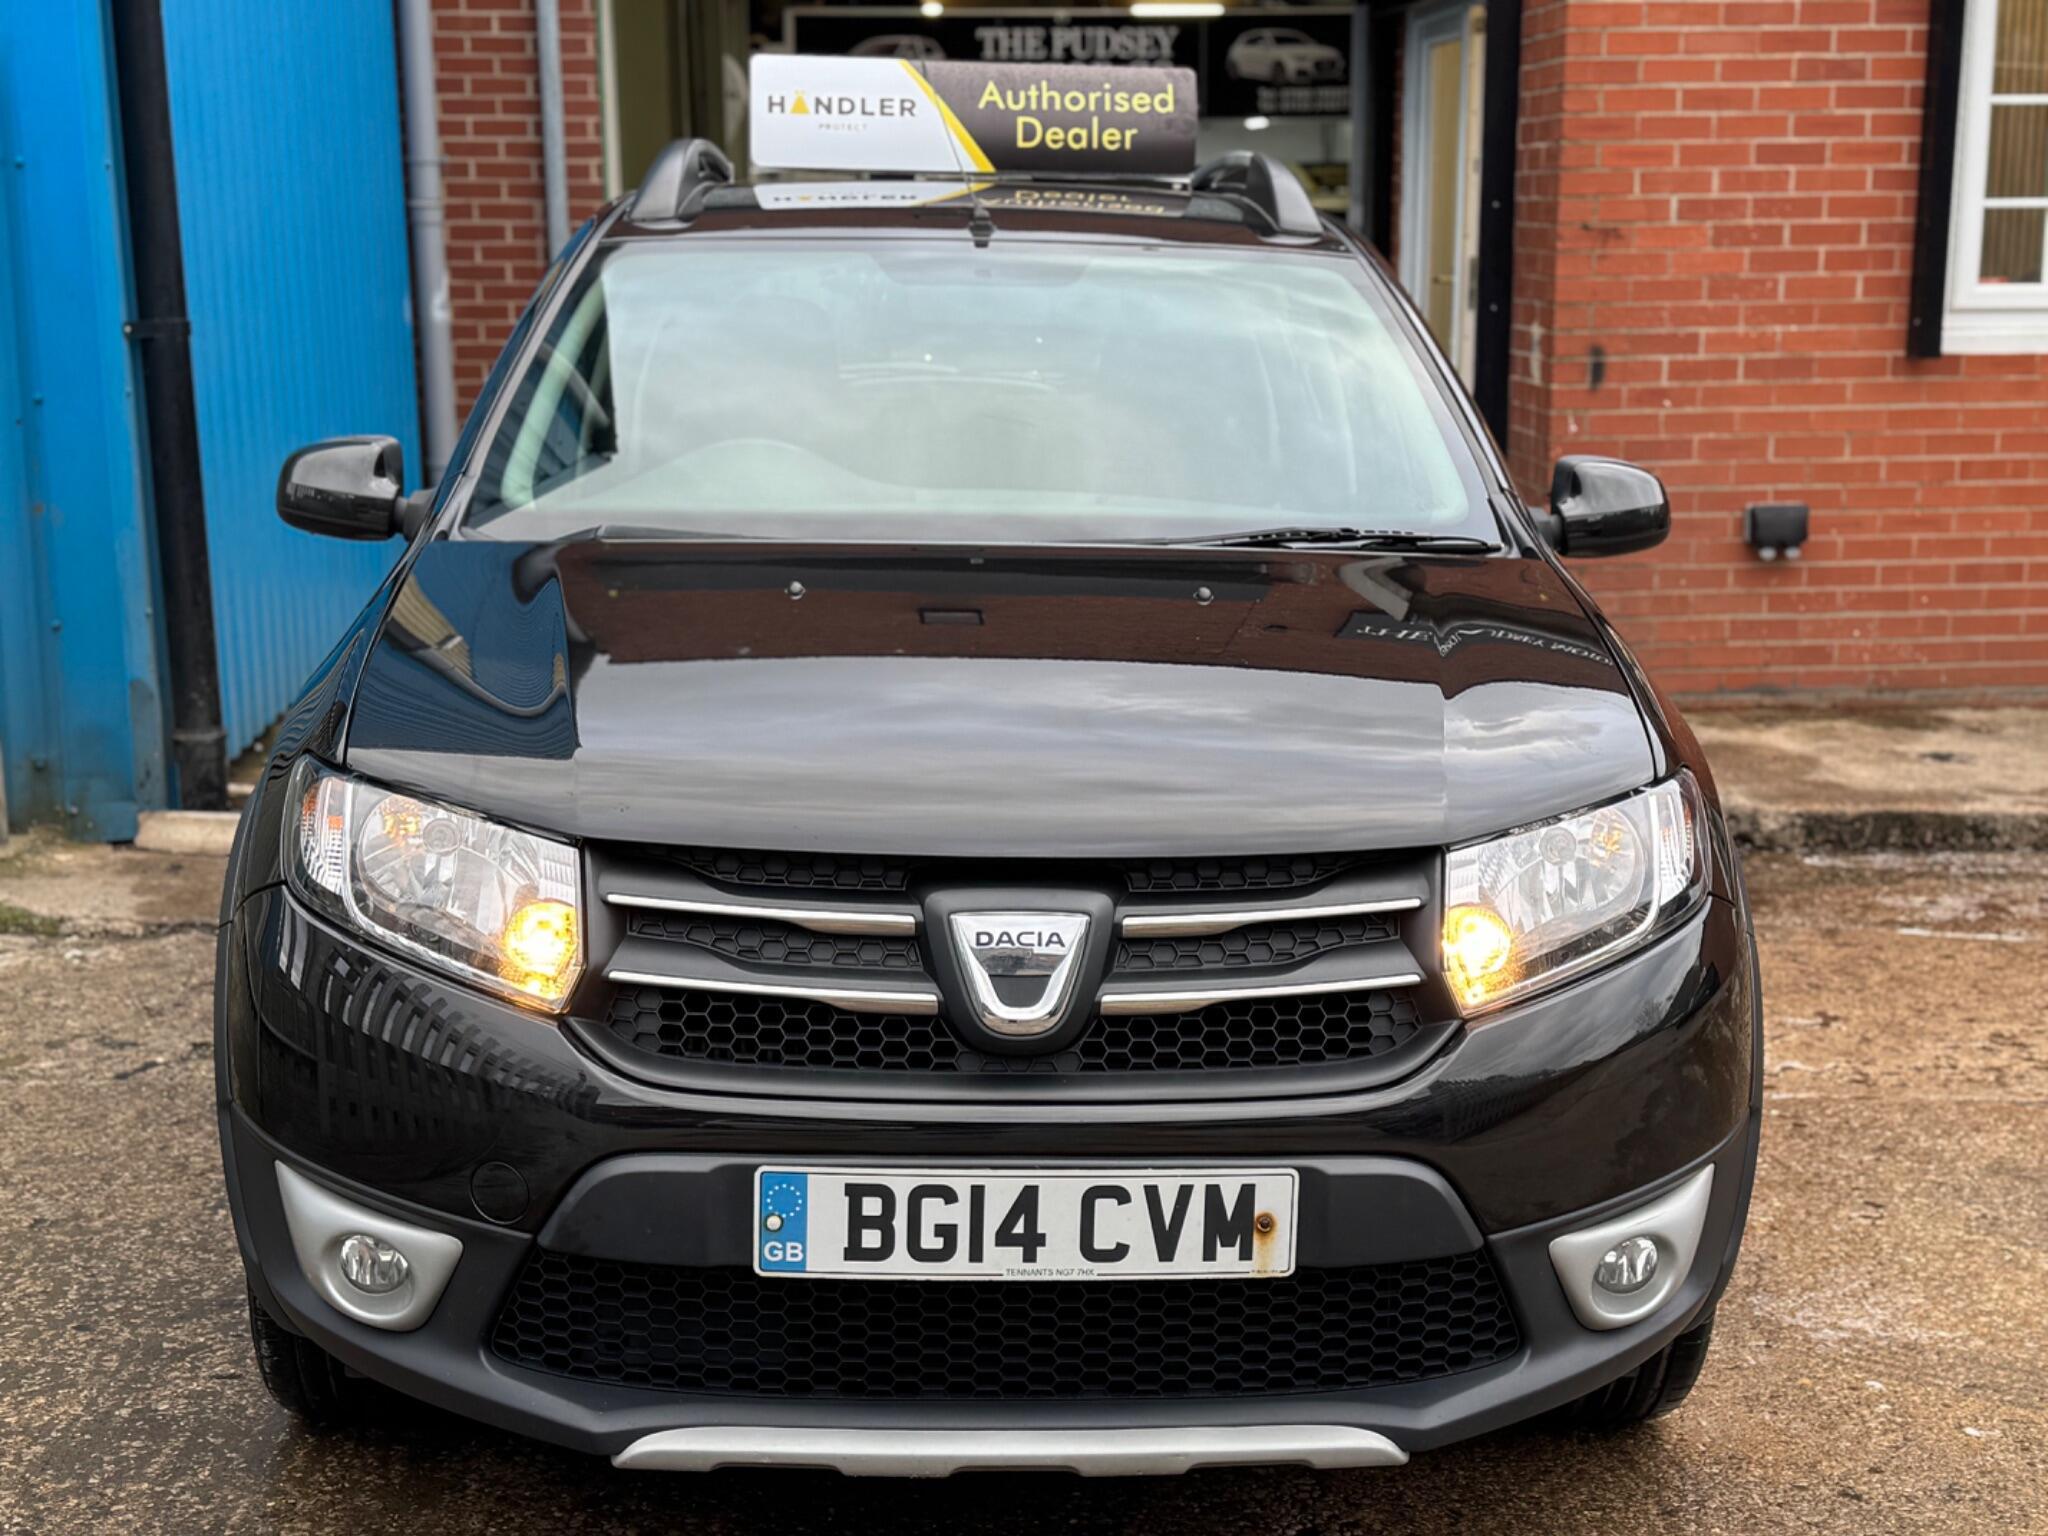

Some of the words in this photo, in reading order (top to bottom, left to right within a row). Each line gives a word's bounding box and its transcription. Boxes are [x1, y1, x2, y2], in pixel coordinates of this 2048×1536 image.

[974, 26, 1047, 59] THE
[1051, 26, 1180, 60] PUDSEY
[977, 80, 1175, 113] Authorised
[1016, 115, 1138, 150] Dealer
[975, 931, 1066, 947] DACIA
[843, 1183, 1046, 1263] BG14
[1080, 1184, 1256, 1263] CVM
[764, 1241, 803, 1262] GB
[1006, 1268, 1053, 1277] TENNANTS
[1056, 1268, 1075, 1277] NG7
